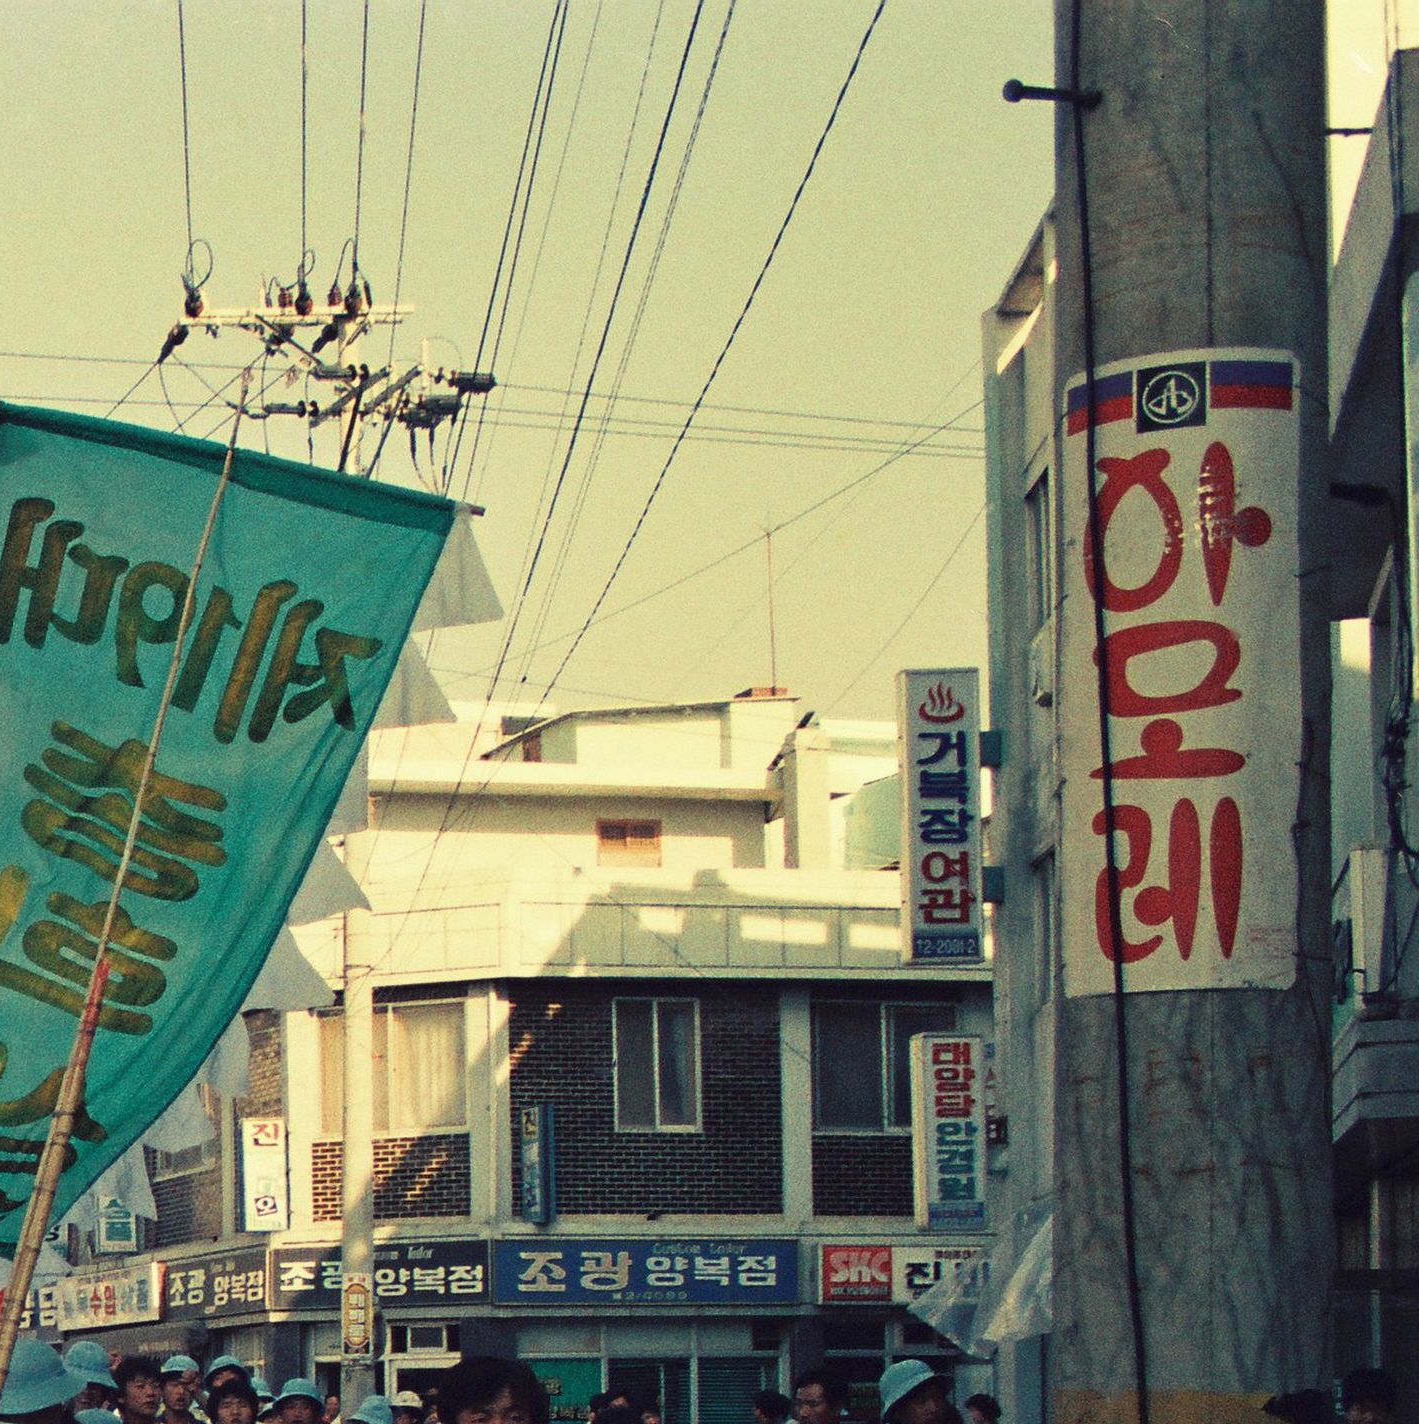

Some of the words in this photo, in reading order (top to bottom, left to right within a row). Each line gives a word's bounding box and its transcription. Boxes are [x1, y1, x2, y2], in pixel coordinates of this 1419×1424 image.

[1083, 441, 1272, 964] 아모레
[252, 1123, 280, 1147] 진
[375, 1265, 484, 1297] 양복점
[517, 1251, 633, 1292] 조광
[645, 1255, 777, 1286] 양복점
[829, 1252, 891, 1283] SKC
[169, 1268, 207, 1307] 조광
[213, 1269, 264, 1307] 양복점
